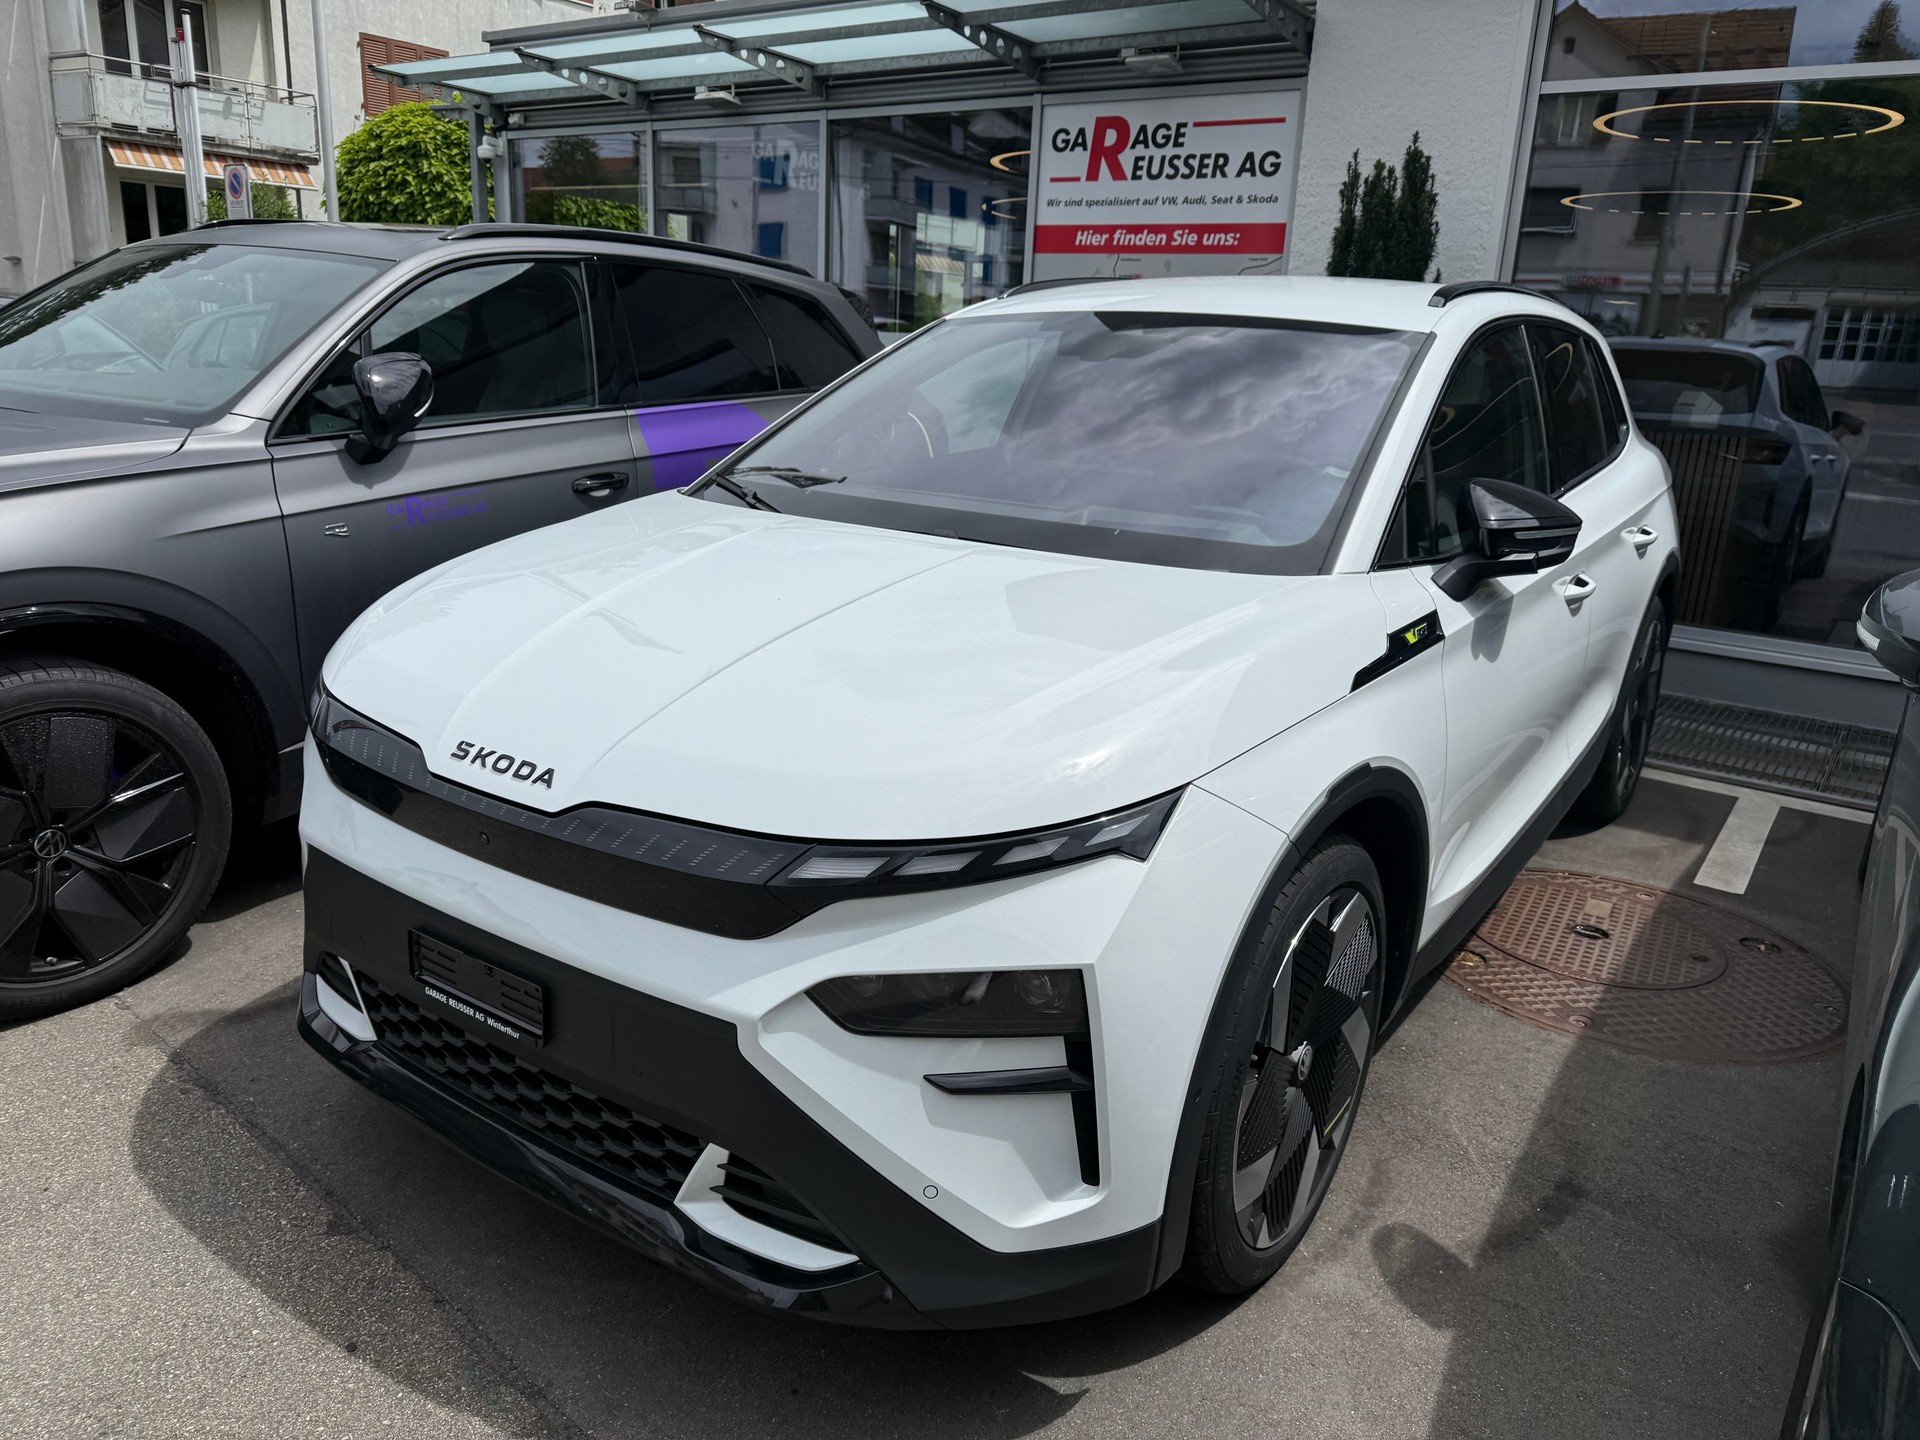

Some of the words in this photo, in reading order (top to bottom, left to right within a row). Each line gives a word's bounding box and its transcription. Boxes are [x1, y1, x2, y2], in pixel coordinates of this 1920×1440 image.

[1051, 115, 1188, 182] GARAGE
[1234, 150, 1282, 178] AG
[1046, 197, 1062, 208] Wir
[1064, 197, 1084, 207] sind
[1085, 196, 1141, 209] spezialisiert
[1142, 195, 1160, 206] auf
[1161, 195, 1179, 206] VW,
[1181, 195, 1208, 206] Audi,
[1211, 194, 1234, 205] Seat
[1236, 194, 1244, 204] &
[1246, 193, 1279, 204] Skoda
[1075, 230, 1109, 246] Hier
[1112, 229, 1167, 246] finden
[1171, 229, 1198, 246] Sie
[1202, 232, 1241, 246] uns:
[450, 740, 555, 789] SKODA
[425, 986, 447, 1004] GARAGE
[448, 998, 474, 1017] REUSSER
[475, 1011, 485, 1022] AG
[487, 1016, 520, 1039] Winterthur
